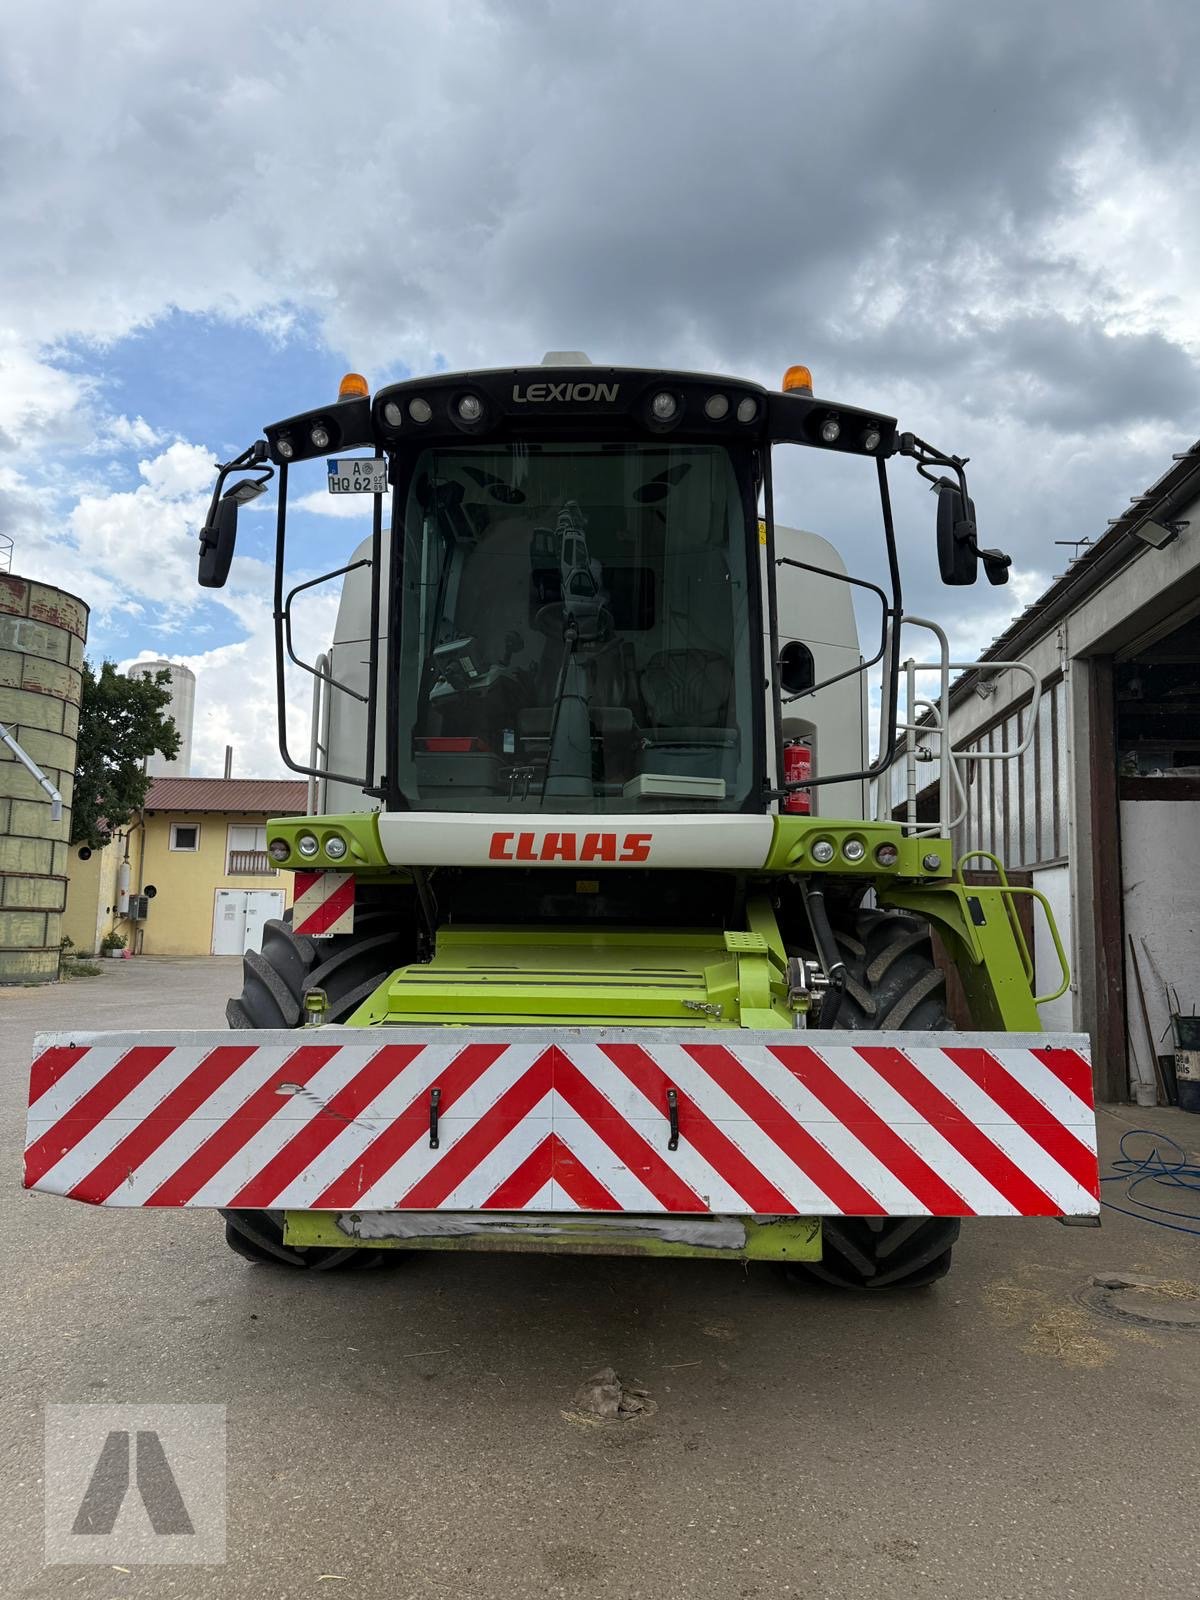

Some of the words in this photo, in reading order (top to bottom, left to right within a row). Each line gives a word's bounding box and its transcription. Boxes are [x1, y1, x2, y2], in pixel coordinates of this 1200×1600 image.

[512, 383, 620, 403] LEXION
[352, 462, 361, 475] A
[332, 477, 350, 491] HQ
[353, 477, 371, 491] 62
[489, 832, 653, 862] CLAAS
